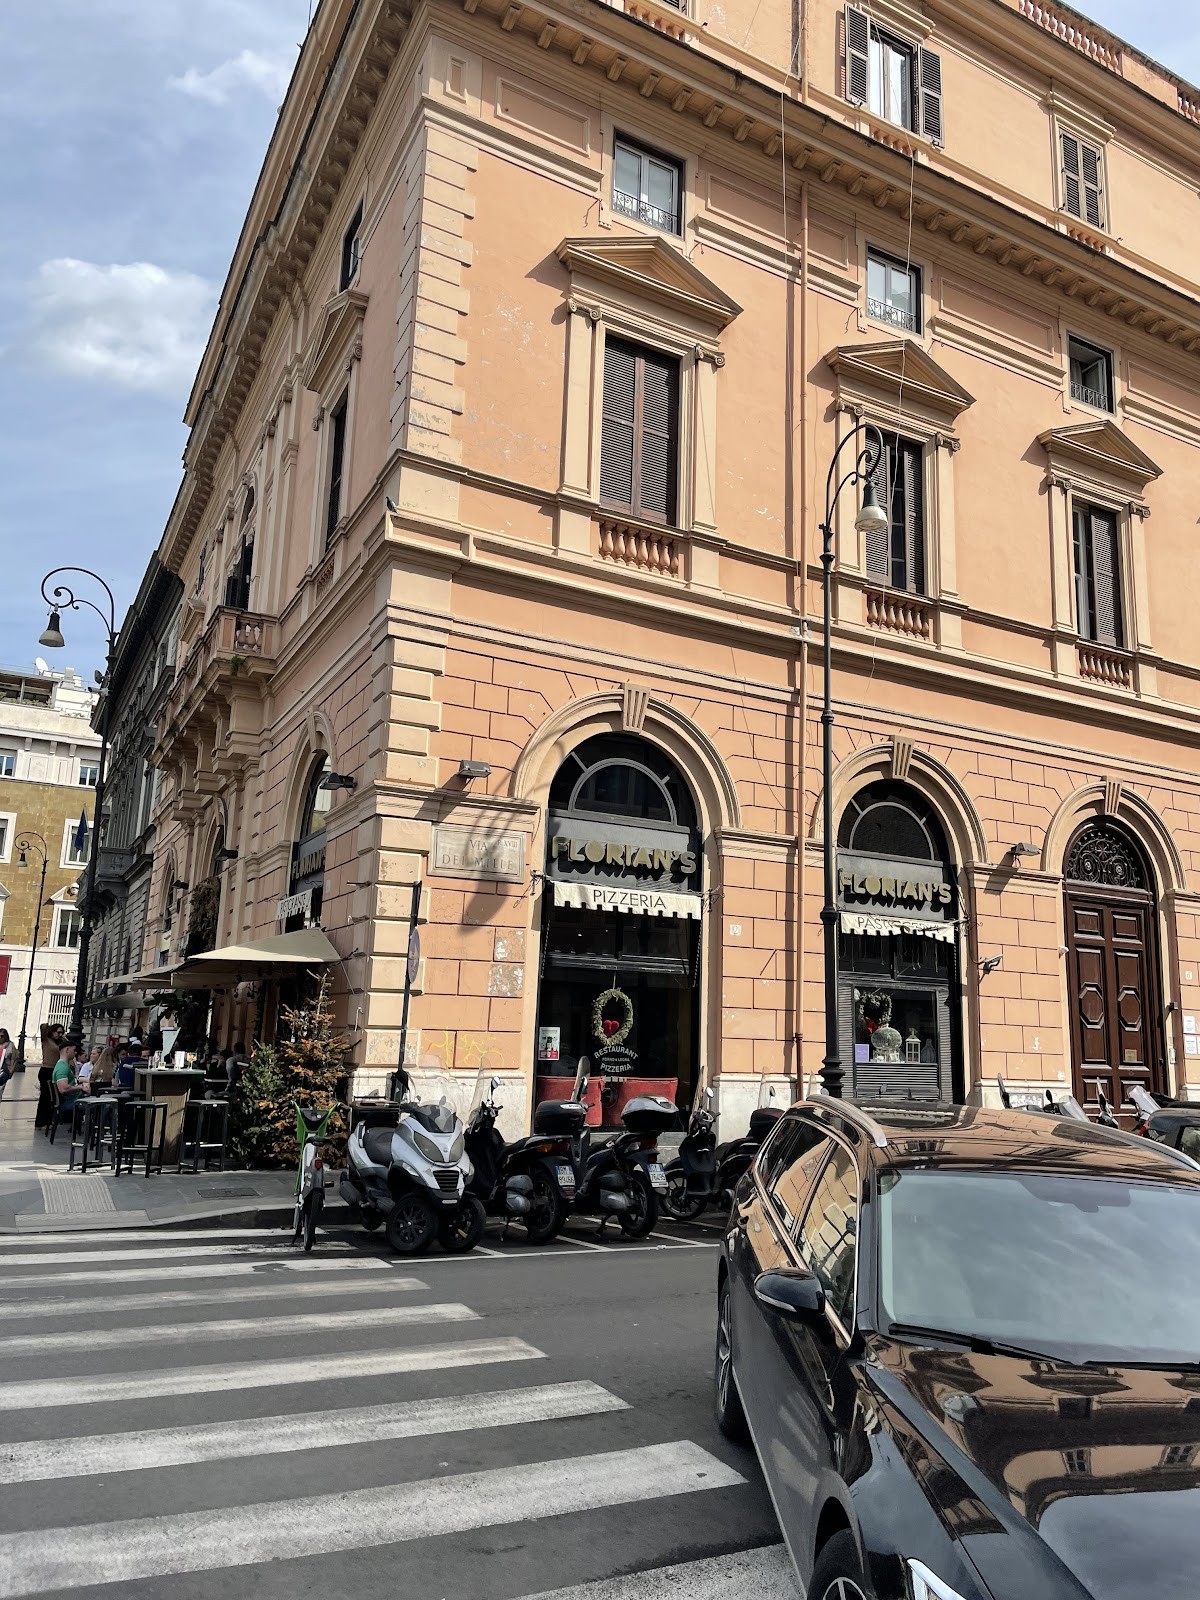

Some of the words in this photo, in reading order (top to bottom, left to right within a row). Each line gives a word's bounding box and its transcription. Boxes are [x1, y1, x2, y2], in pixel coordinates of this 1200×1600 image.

[470, 840, 488, 851] VIA
[442, 854, 465, 866] DEI
[474, 857, 514, 870] MILLE
[552, 836, 697, 874] FLORIAN'S
[839, 869, 952, 904] FLORIAN'S
[593, 889, 667, 910] PIZZERIA
[593, 1046, 639, 1060] RESTAURANT
[600, 1063, 631, 1073] PIZZERIA
